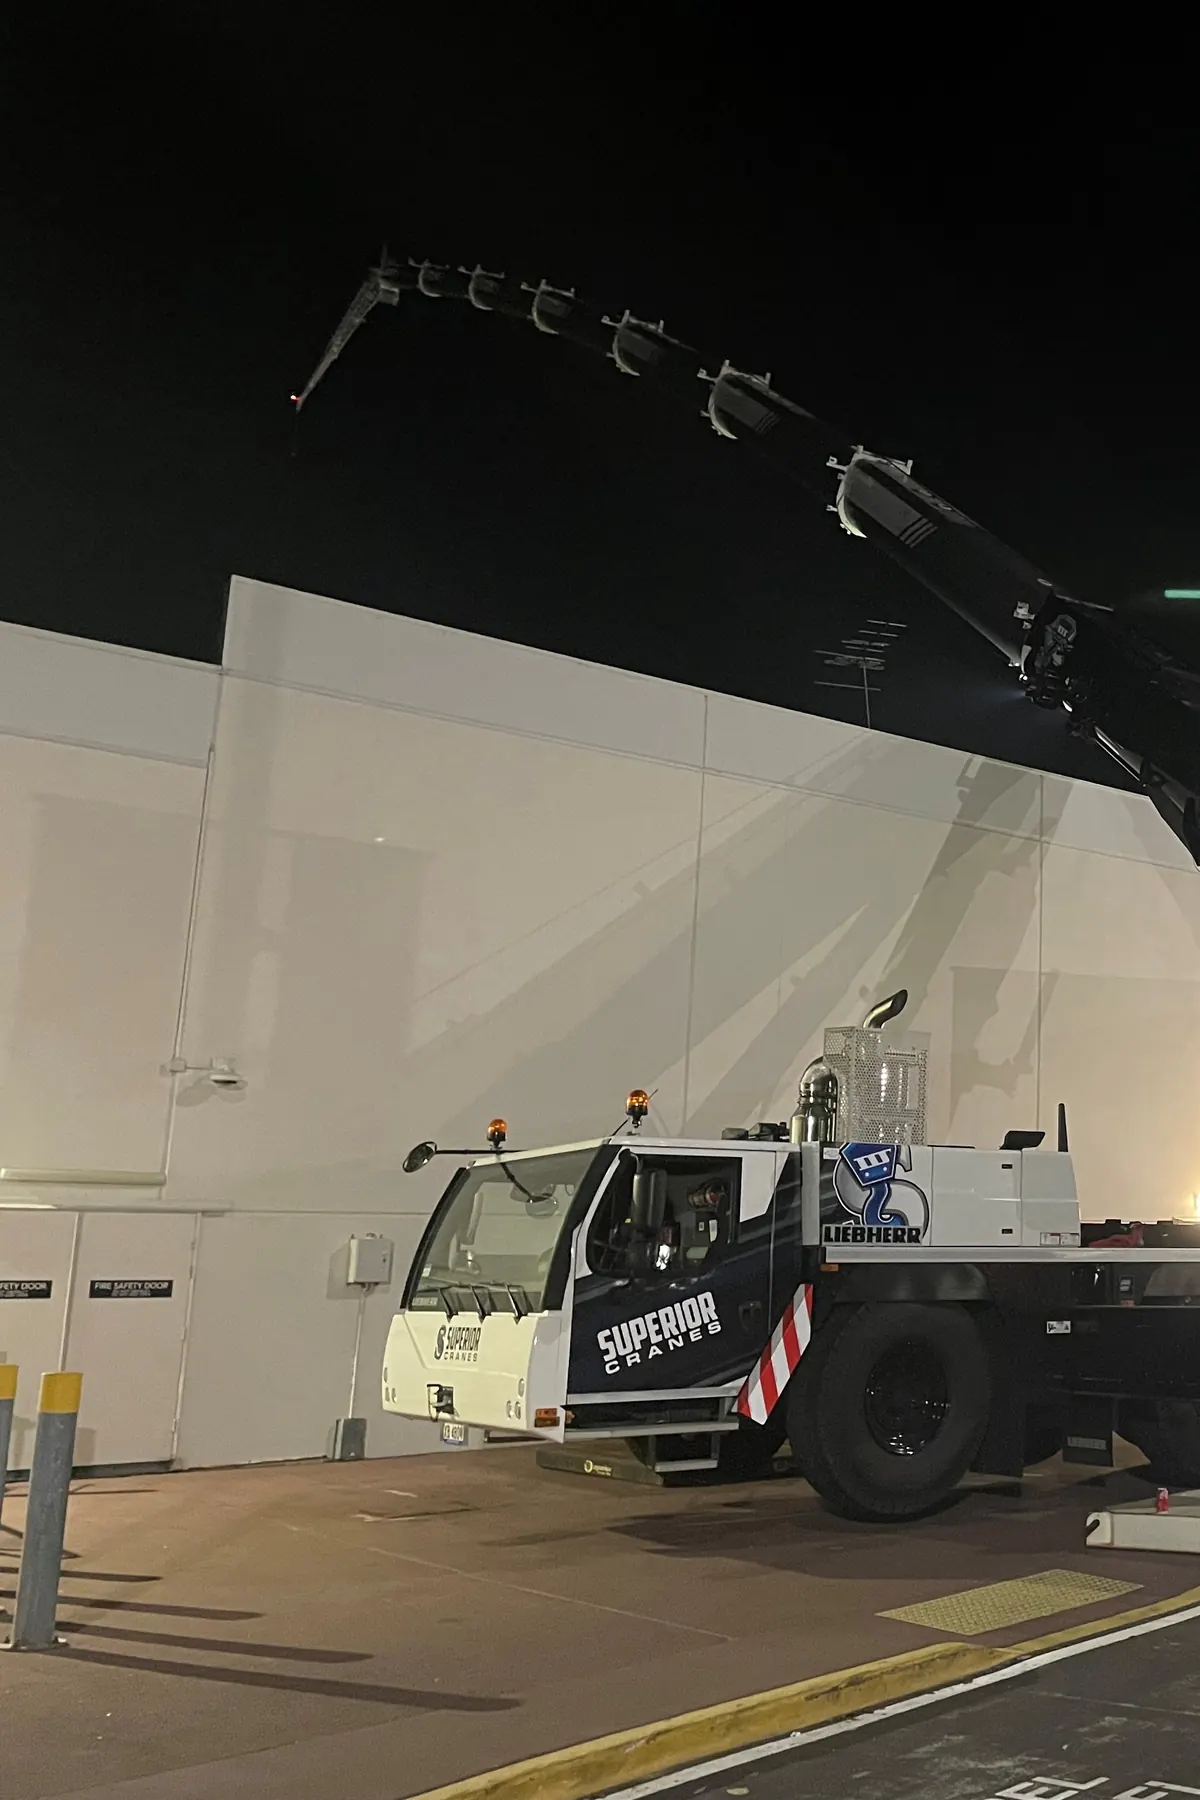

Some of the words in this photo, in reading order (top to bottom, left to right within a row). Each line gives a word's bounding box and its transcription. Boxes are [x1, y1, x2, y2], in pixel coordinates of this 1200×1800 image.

[823, 1226, 921, 1244] LIEBHERR
[94, 1282, 111, 1290] FIRE
[114, 1282, 143, 1290] SAFETY
[144, 1282, 168, 1290] DOOR
[597, 1291, 718, 1361] SUPERIOR
[446, 1327, 481, 1352] SUPERIOR
[605, 1321, 721, 1374] CRANES
[444, 1352, 478, 1362] CRANES
